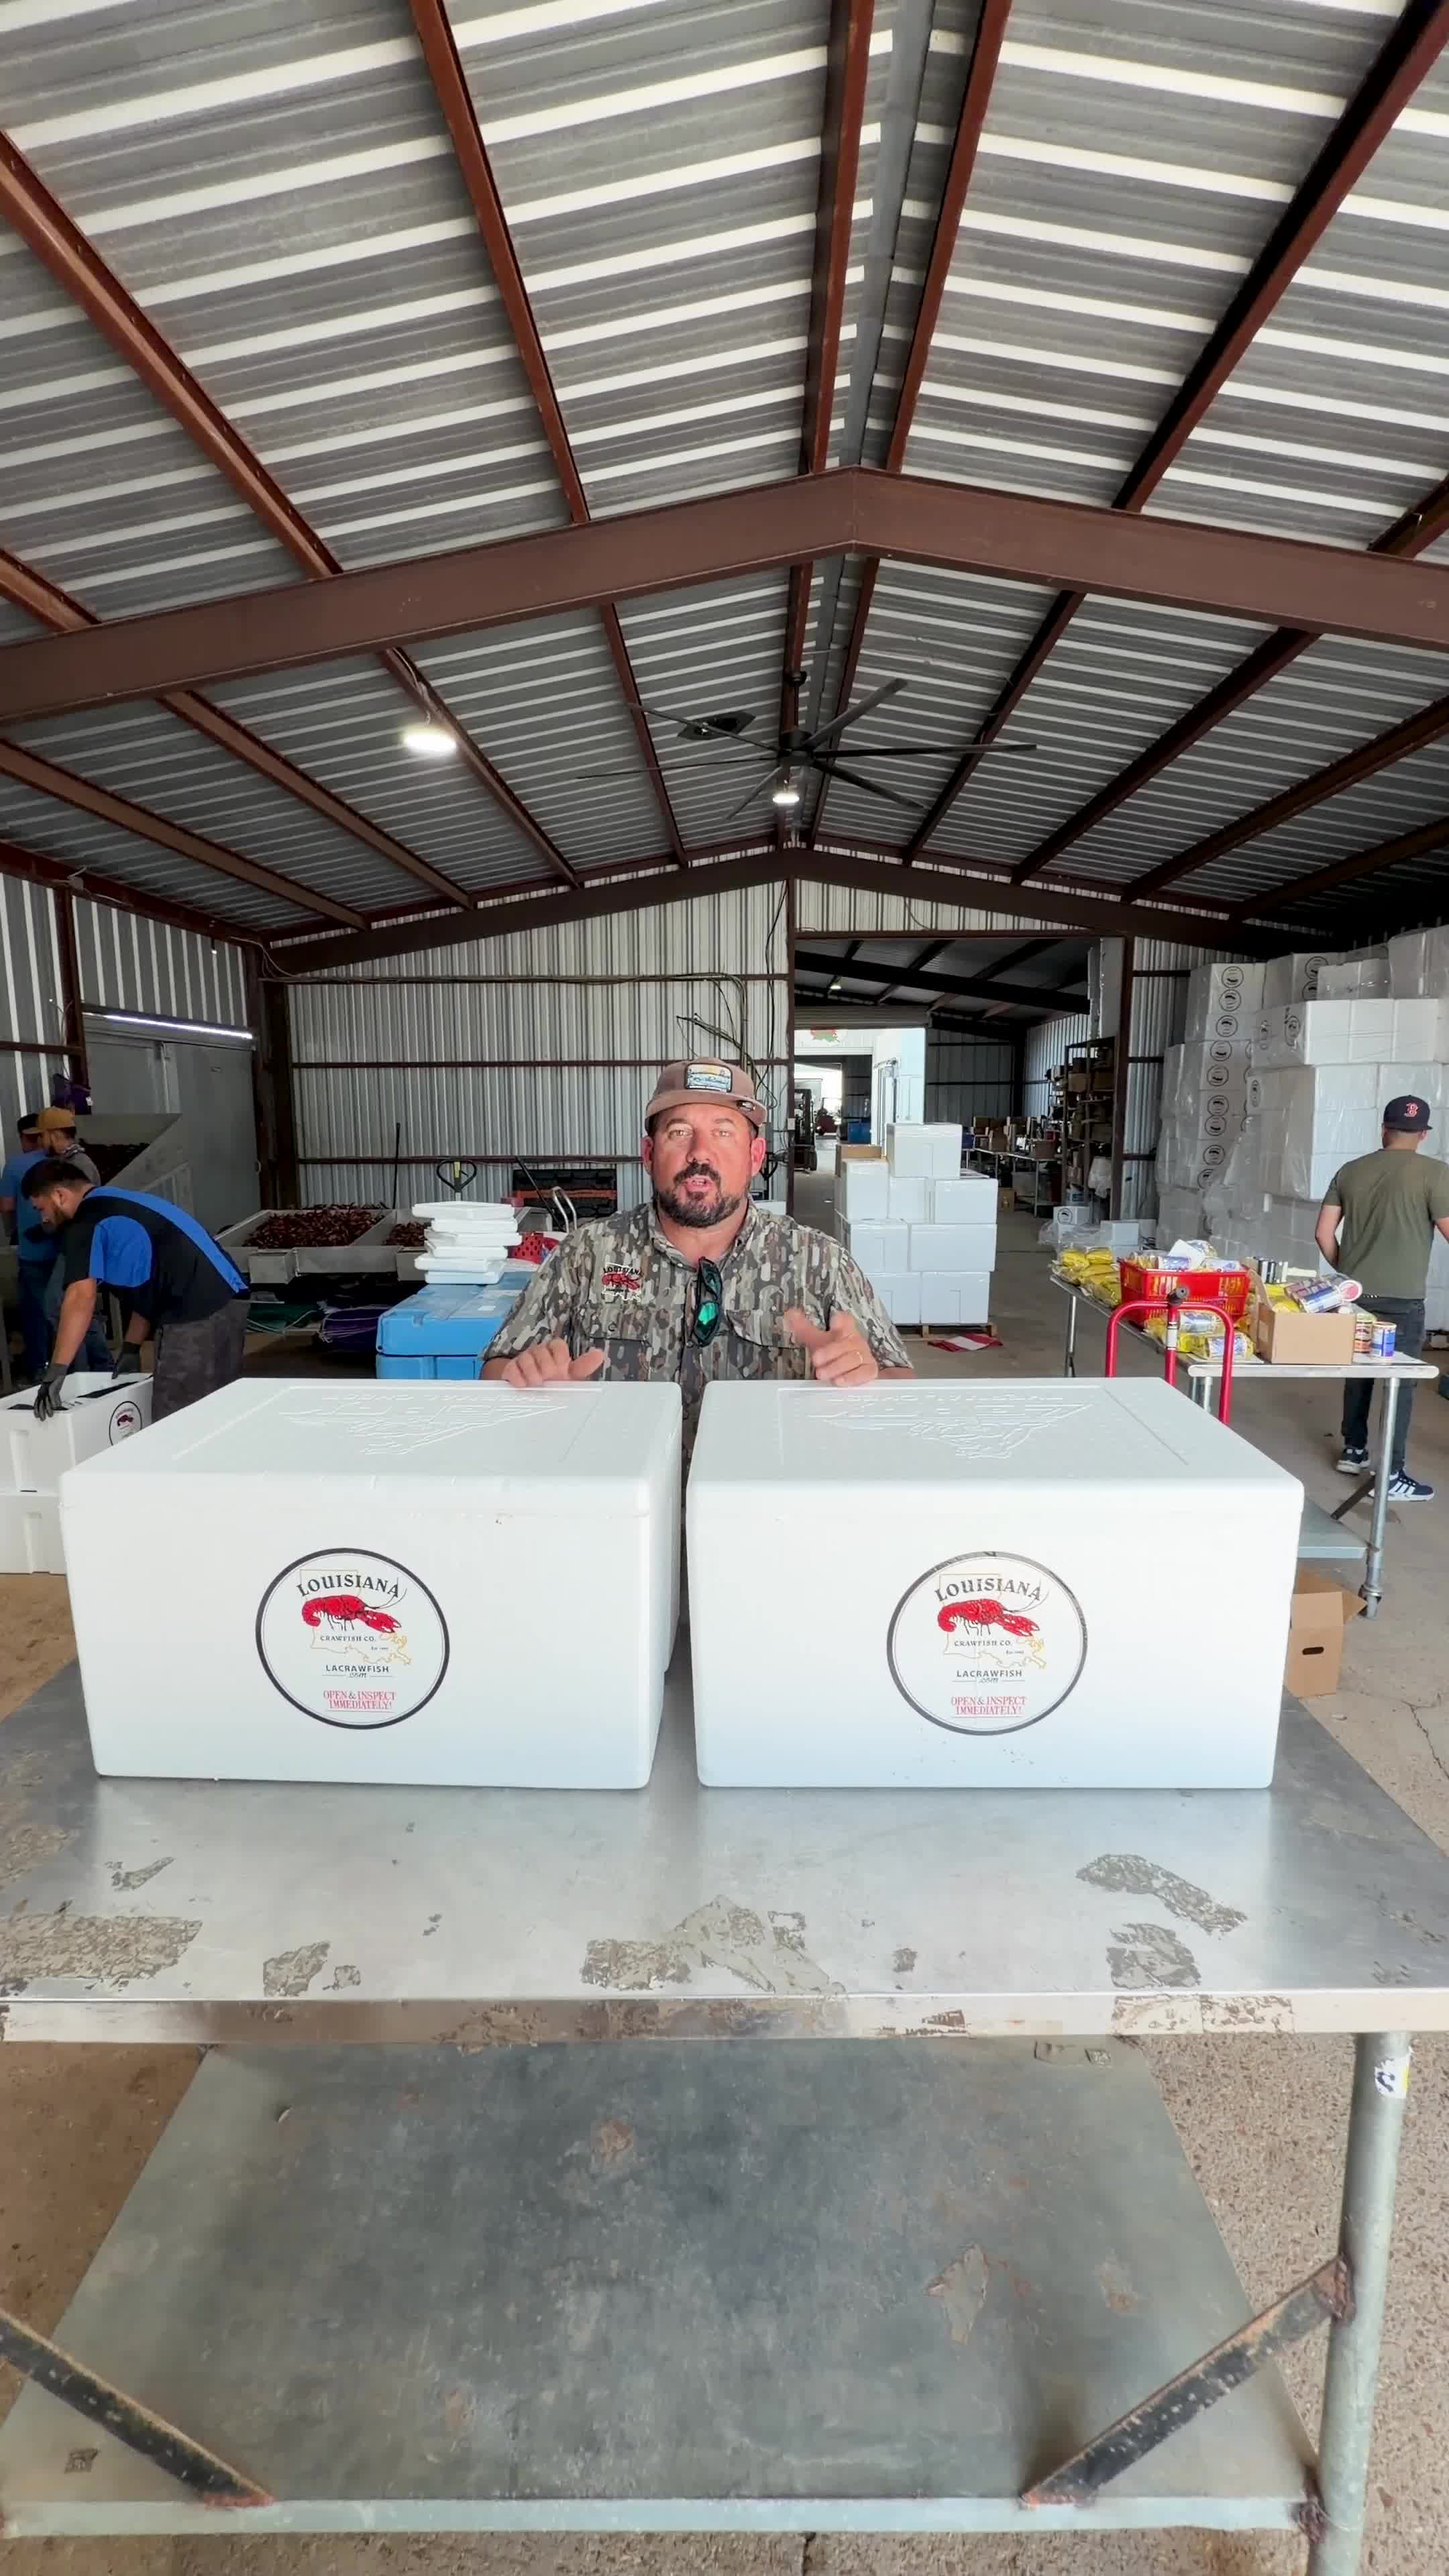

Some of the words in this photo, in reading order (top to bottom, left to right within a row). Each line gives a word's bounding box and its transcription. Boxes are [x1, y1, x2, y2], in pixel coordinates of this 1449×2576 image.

[297, 1574, 398, 1597] LOUISIANA
[934, 1578, 1041, 1601] LOUISIANA
[325, 1664, 389, 1673] LACRAWFISH
[957, 1670, 1022, 1678] LACRAWFISH
[323, 1690, 347, 1700] OPEN
[348, 1690, 357, 1700] &
[358, 1690, 395, 1701] INSPECT
[329, 1700, 392, 1710] IMMEDIATELY!
[951, 1696, 977, 1706] OPEN
[977, 1696, 985, 1706] &
[987, 1696, 1026, 1705] INSPECT
[956, 1706, 1022, 1715] IMMEDIATELY!
